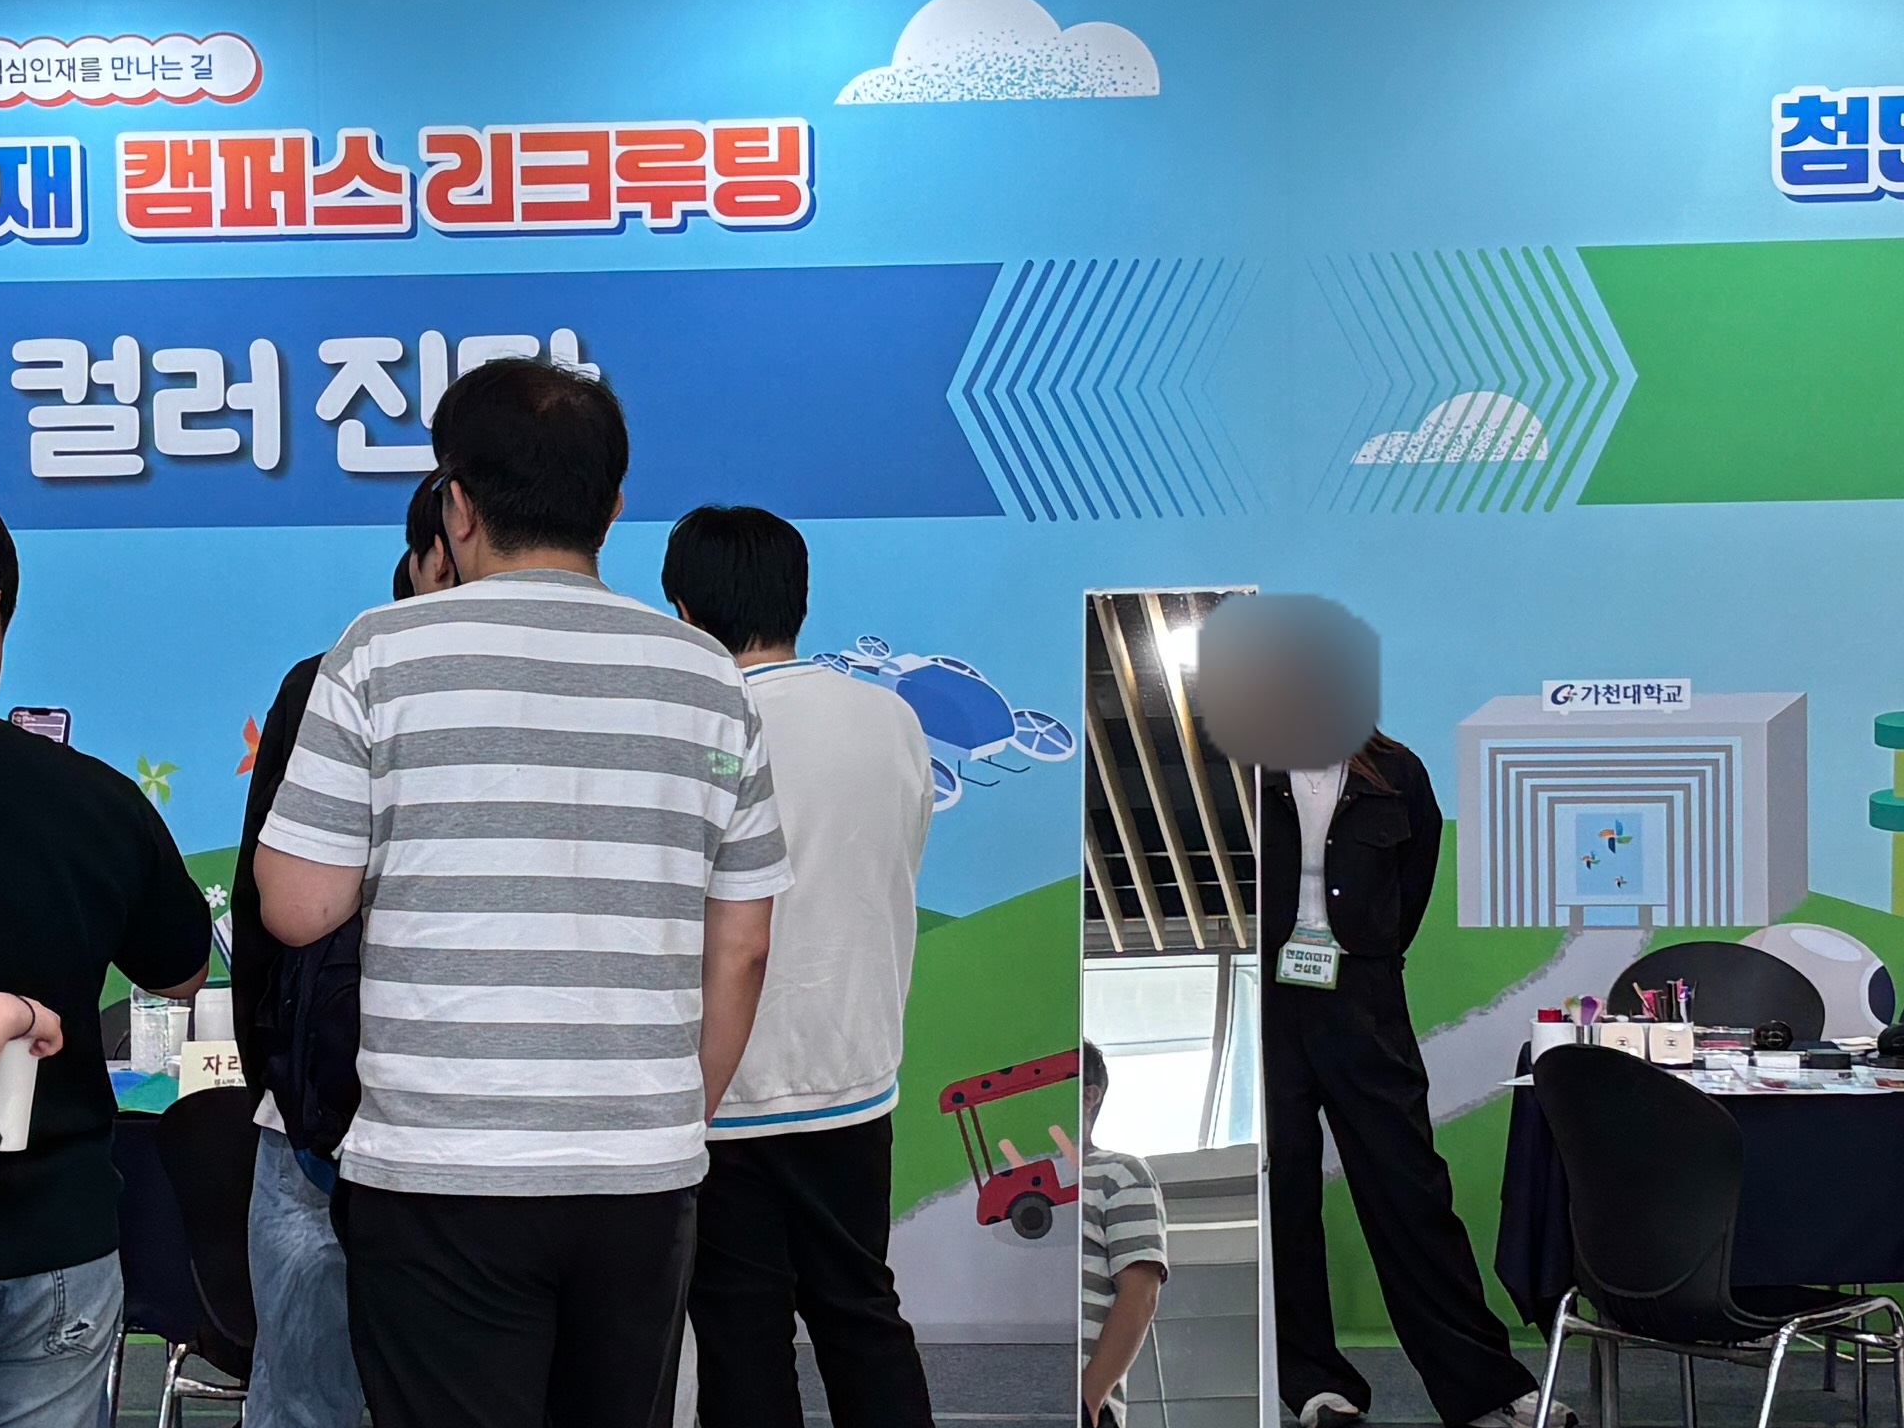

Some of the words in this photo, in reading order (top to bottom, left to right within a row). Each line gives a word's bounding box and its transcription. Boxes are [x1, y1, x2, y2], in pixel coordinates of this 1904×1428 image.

[110, 54, 184, 83] 만나는
[190, 53, 215, 81] 길
[123, 135, 404, 227] 캠퍼스
[425, 125, 802, 223] 리크루팅
[10, 334, 281, 479] 컬러
[1581, 683, 1684, 705] 가천대학교
